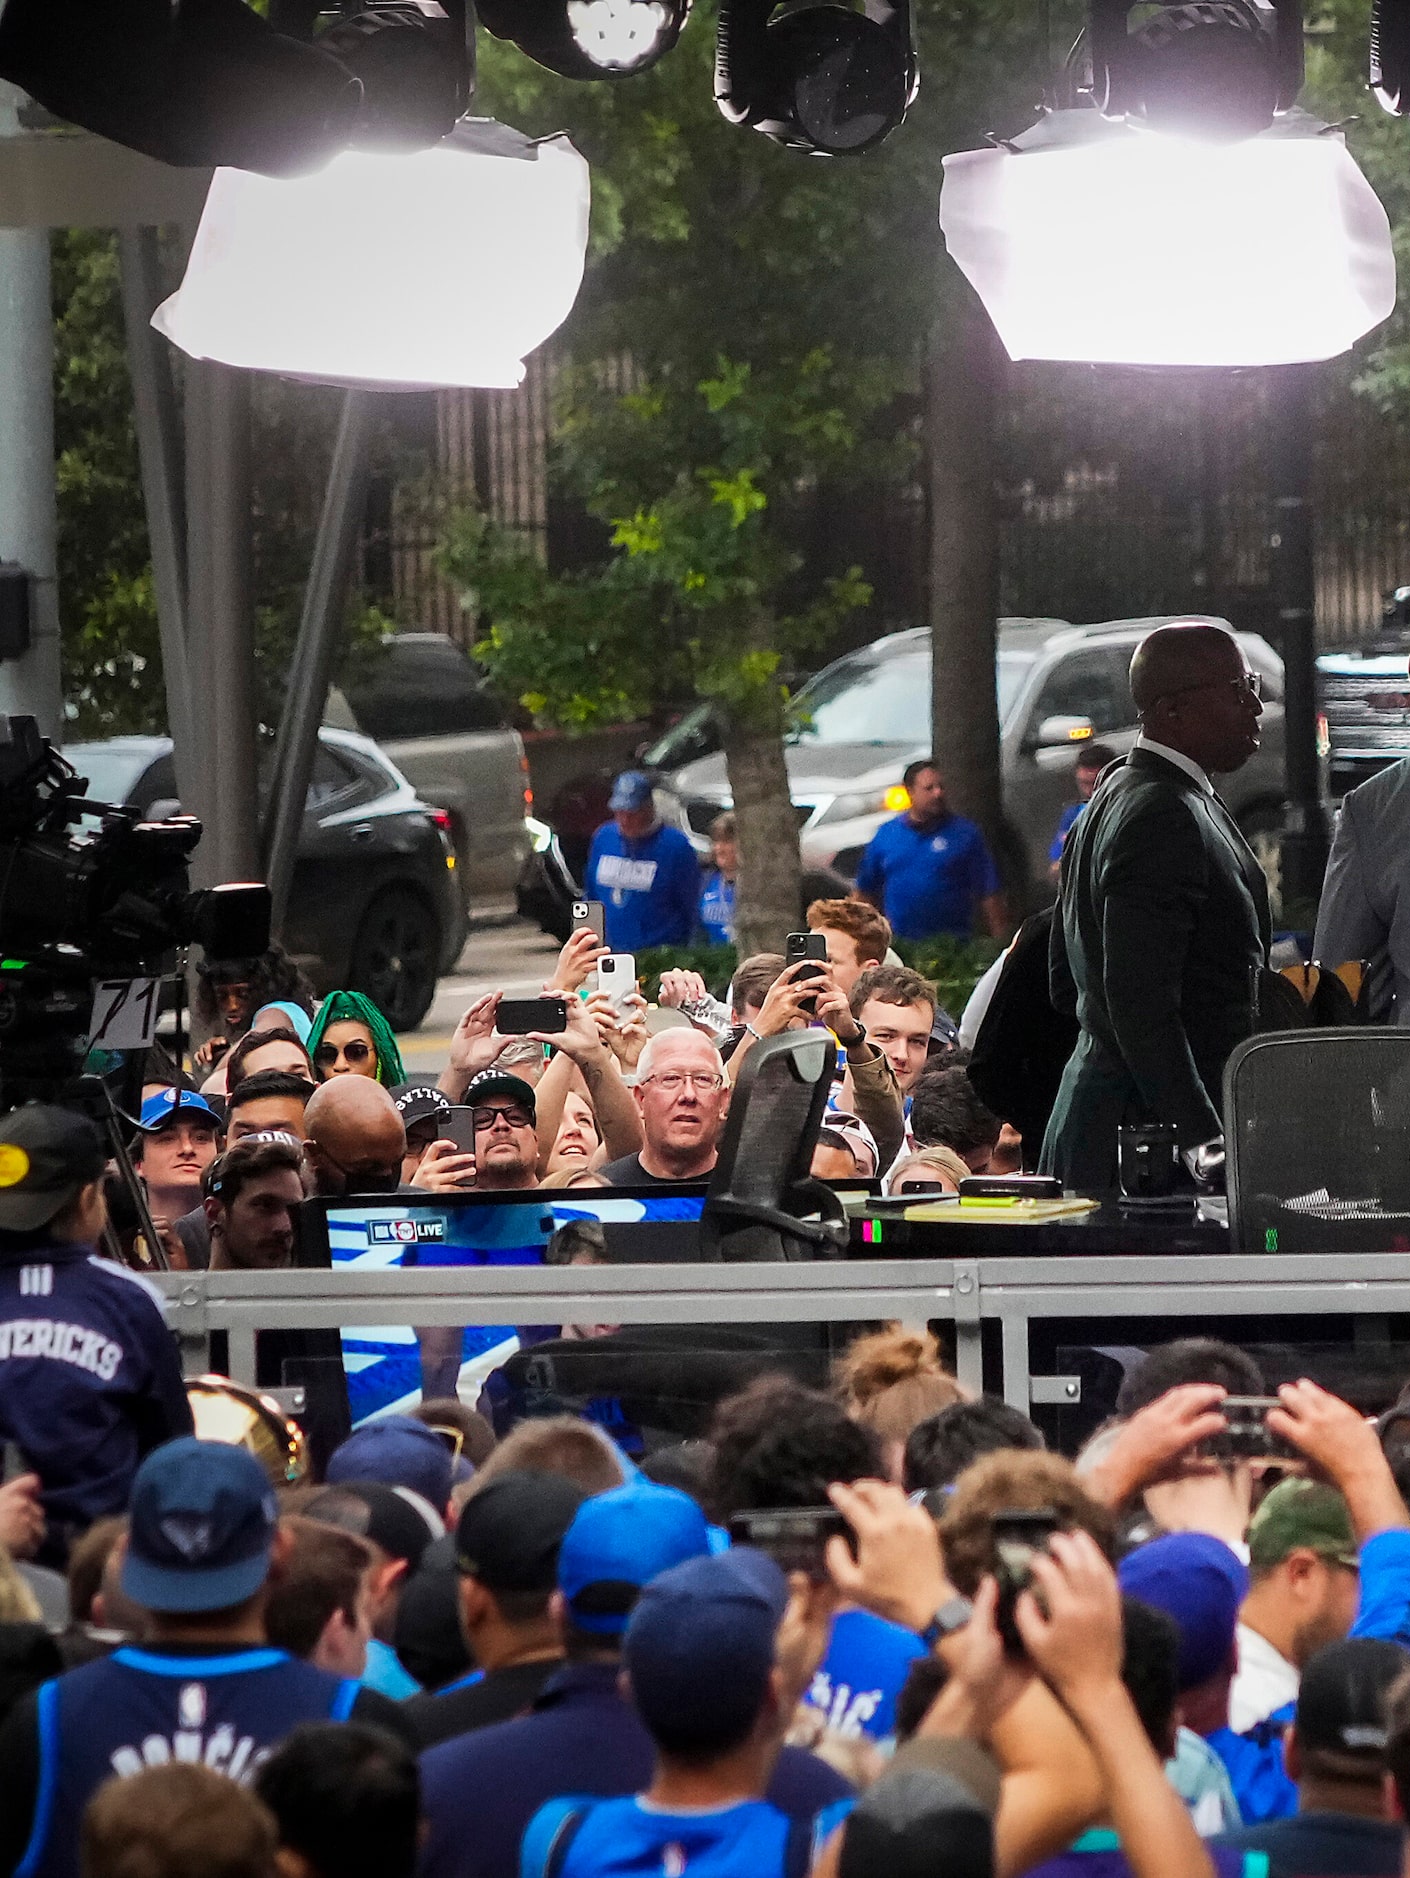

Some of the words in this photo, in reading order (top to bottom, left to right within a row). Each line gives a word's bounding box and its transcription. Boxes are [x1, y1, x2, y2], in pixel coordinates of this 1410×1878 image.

[98, 982, 155, 1039] 71
[395, 1087, 449, 1110] DALLAS
[417, 1223, 443, 1237] LIVE
